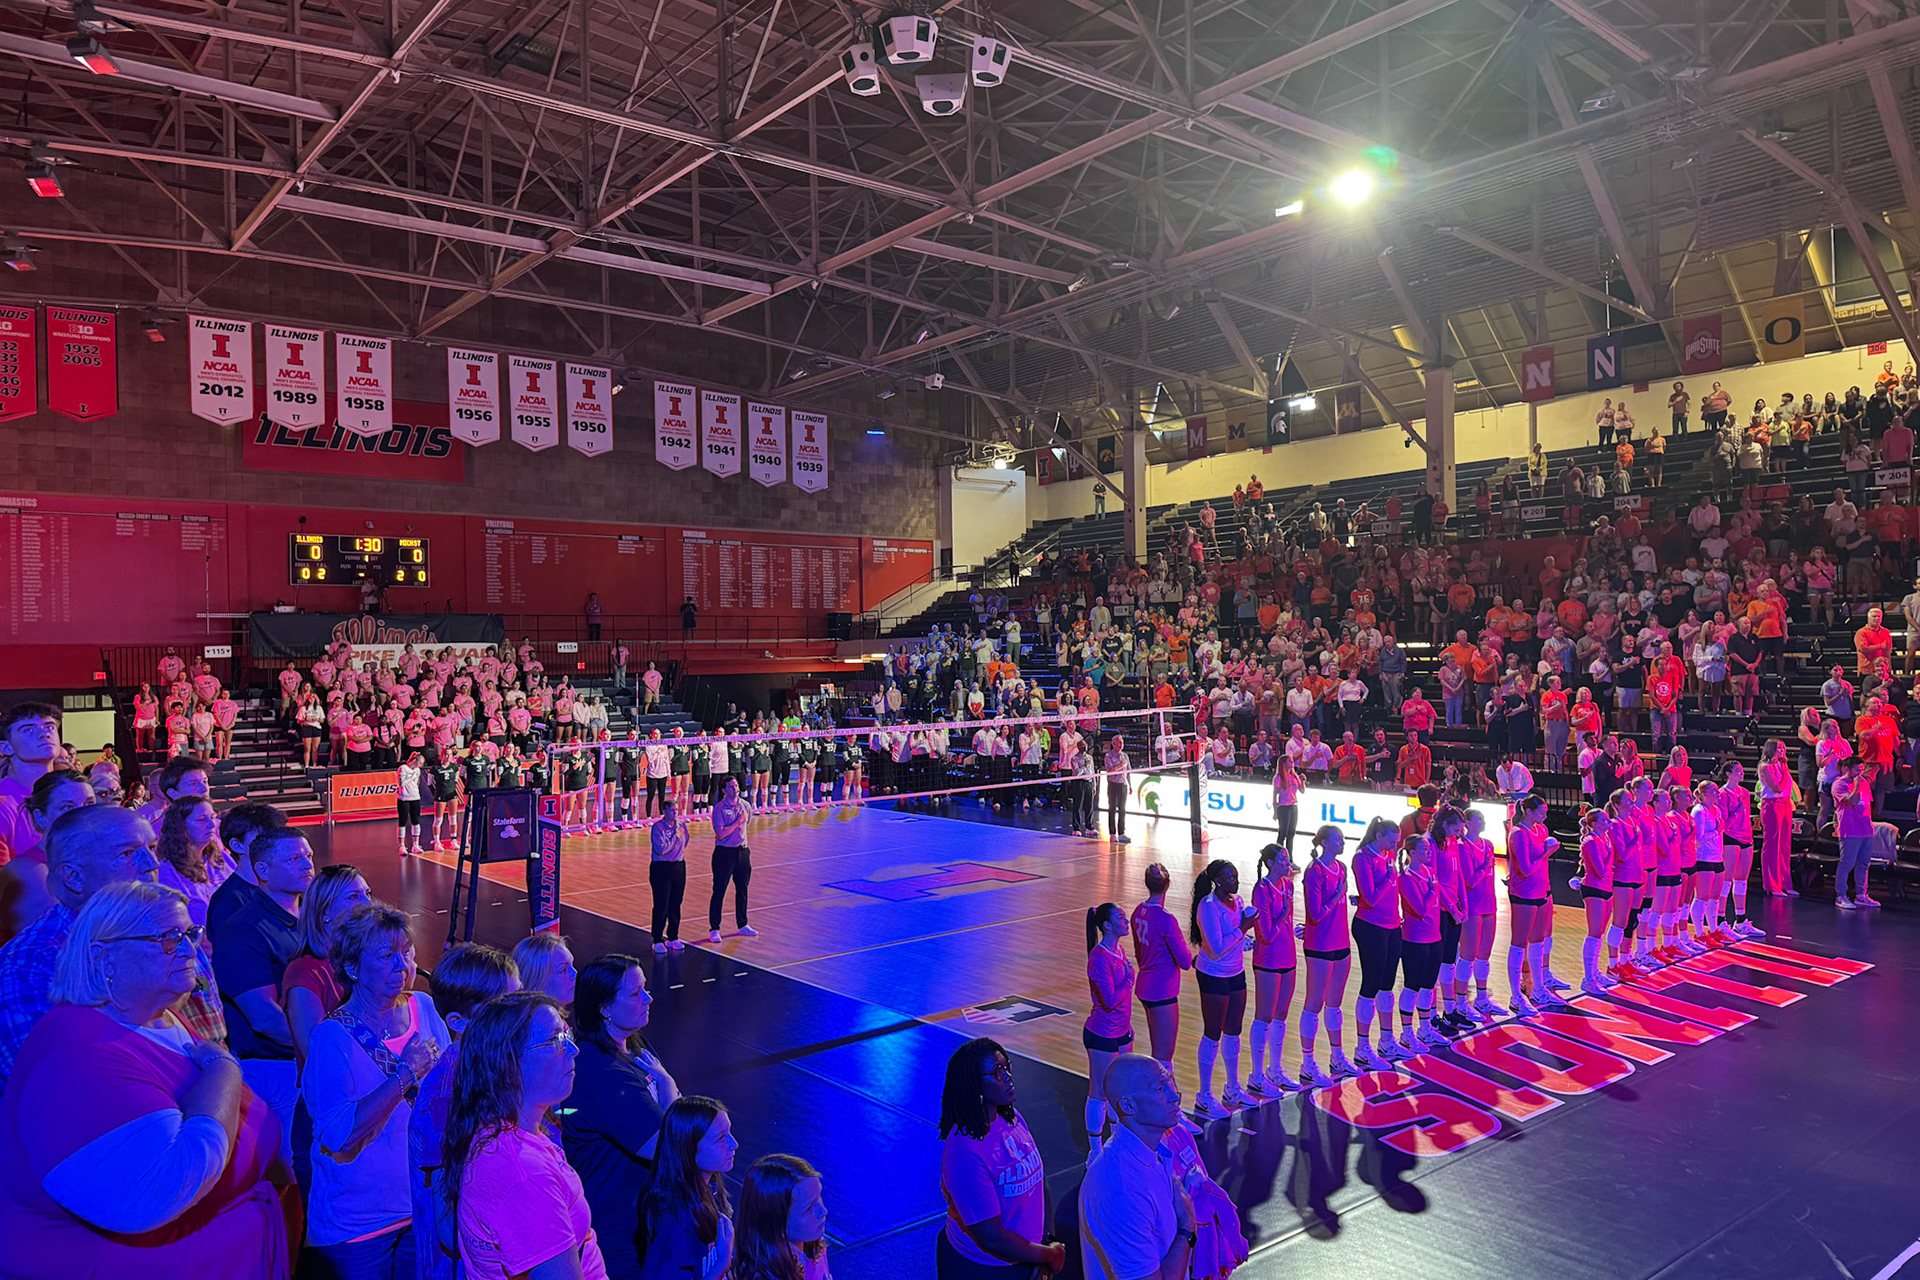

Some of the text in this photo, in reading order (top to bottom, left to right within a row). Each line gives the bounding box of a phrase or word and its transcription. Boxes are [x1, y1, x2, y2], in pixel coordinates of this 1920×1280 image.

[54, 311, 110, 324] ILLINOIS
[195, 320, 246, 333] ILLINOIS
[1764, 316, 1801, 345] O
[271, 329, 319, 342] ILLINOIS
[65, 344, 99, 355] 1952
[212, 334, 230, 358] I
[341, 337, 387, 350] ILLINOIS
[63, 355, 101, 367] 2005
[287, 343, 304, 366] I
[452, 351, 494, 363] ILLINOIS
[203, 361, 238, 373] NCAA
[356, 351, 373, 374] I
[513, 359, 552, 371] ILLINOIS
[1594, 345, 1615, 380] N
[278, 369, 311, 380] NCAA
[466, 364, 481, 386] I
[570, 366, 608, 378] ILLINOIS
[1525, 360, 1551, 390] N
[348, 376, 380, 388] NCAA
[526, 372, 541, 393] I
[200, 383, 244, 398] 2012
[459, 388, 488, 399] NCAA
[582, 379, 597, 400] I
[658, 384, 692, 396] ILLINOIS
[273, 390, 318, 405] 1989
[345, 397, 385, 411] 1958
[519, 395, 547, 406] NCAA
[704, 394, 738, 405] ILLINOIS
[575, 401, 601, 412] NCAA
[669, 396, 682, 417] I
[751, 405, 782, 416] ILLINOIS
[456, 408, 492, 422] 1956
[517, 414, 551, 428] 1955
[715, 405, 728, 425] I
[794, 414, 825, 425] ILLINOIS
[572, 420, 607, 434] 1950
[662, 418, 687, 429] NCAA
[762, 417, 774, 436] I
[254, 412, 453, 458] ILLINOIS
[709, 426, 732, 437] NCAA
[804, 425, 816, 444] I
[1189, 427, 1204, 448] M
[1228, 422, 1245, 440] M
[660, 436, 691, 449] 1942
[756, 437, 778, 448] NCAA
[708, 444, 736, 456] 1941
[799, 445, 820, 456] NCAA
[752, 454, 782, 467] 1940
[796, 461, 824, 474] 1939
[1890, 472, 1908, 480] 204
[356, 538, 381, 552] 1:30
[311, 545, 320, 560] 0
[413, 549, 422, 563] 0
[302, 568, 326, 580] 0 2
[396, 570, 426, 582] 2 0
[350, 649, 396, 661] PIKE
[444, 772, 450, 780] 2
[340, 784, 398, 798] ILLINOIS
[1321, 803, 1366, 825] ILL
[541, 828, 556, 918] ILLINOIS
[1309, 939, 1876, 1158] ILLINOIS
[998, 1147, 1042, 1186] ILLINO
